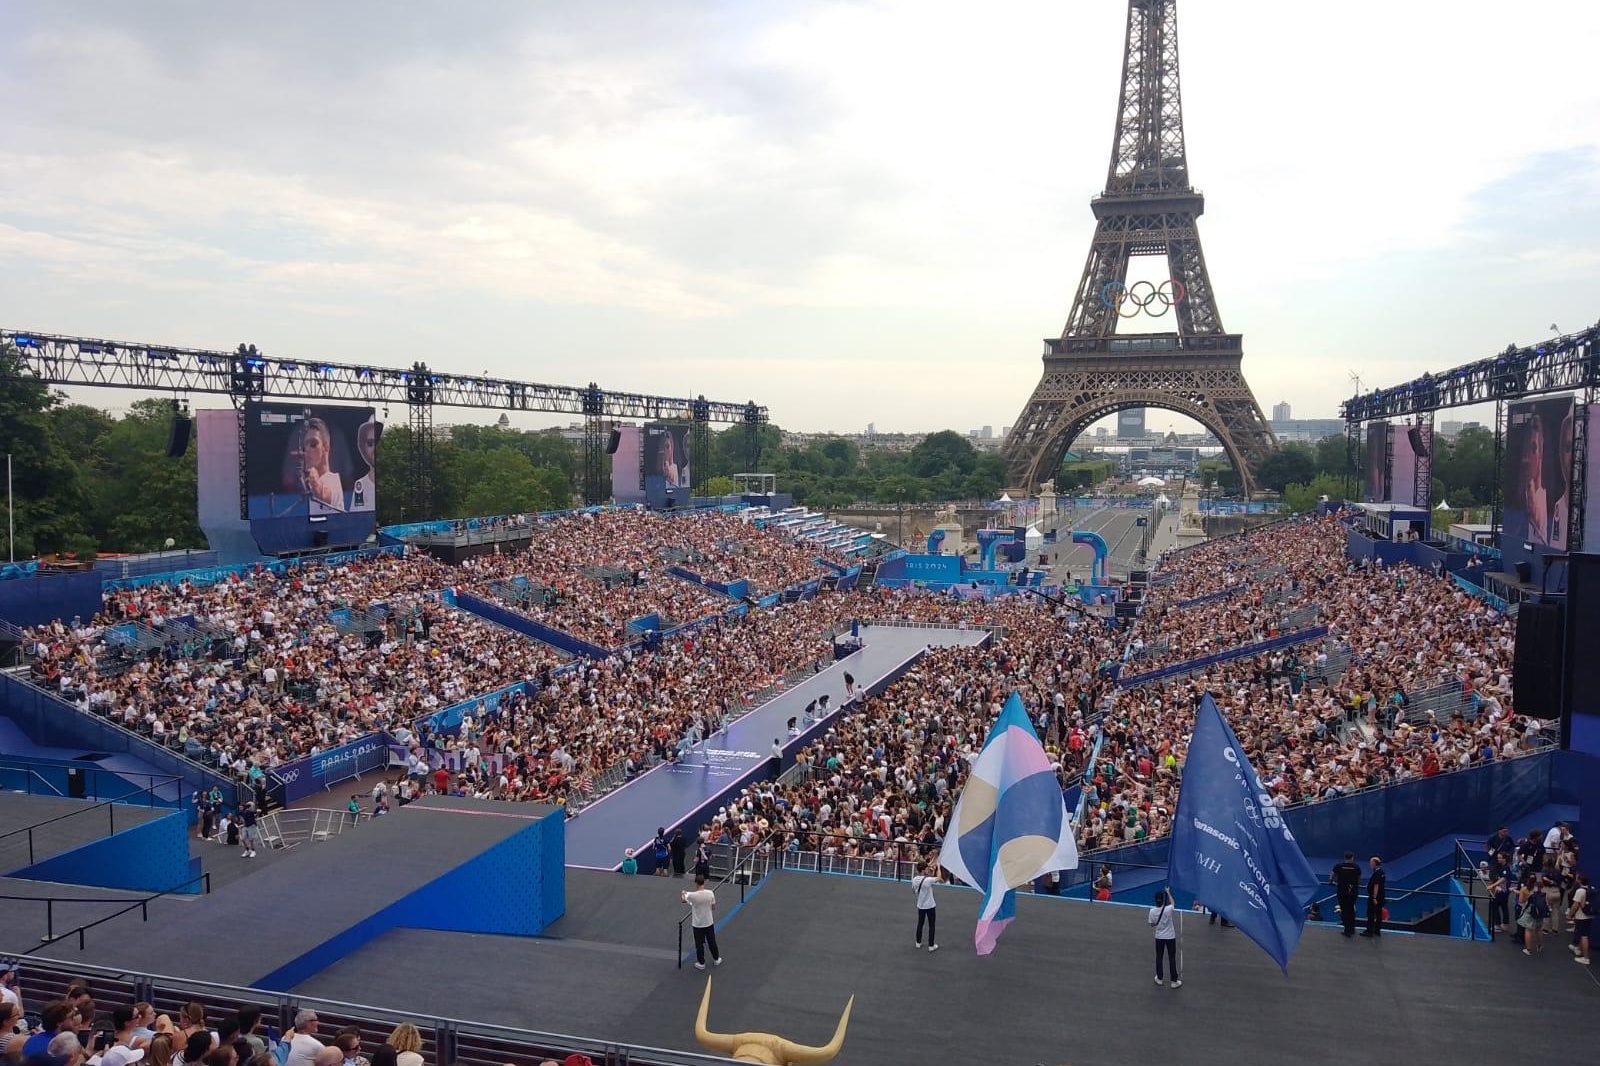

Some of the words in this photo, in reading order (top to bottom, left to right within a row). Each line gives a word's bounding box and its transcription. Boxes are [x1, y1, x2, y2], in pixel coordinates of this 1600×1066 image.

[321, 751, 349, 770] PARIS
[352, 743, 376, 759] 2024
[1243, 849, 1270, 895] TOYOTA
